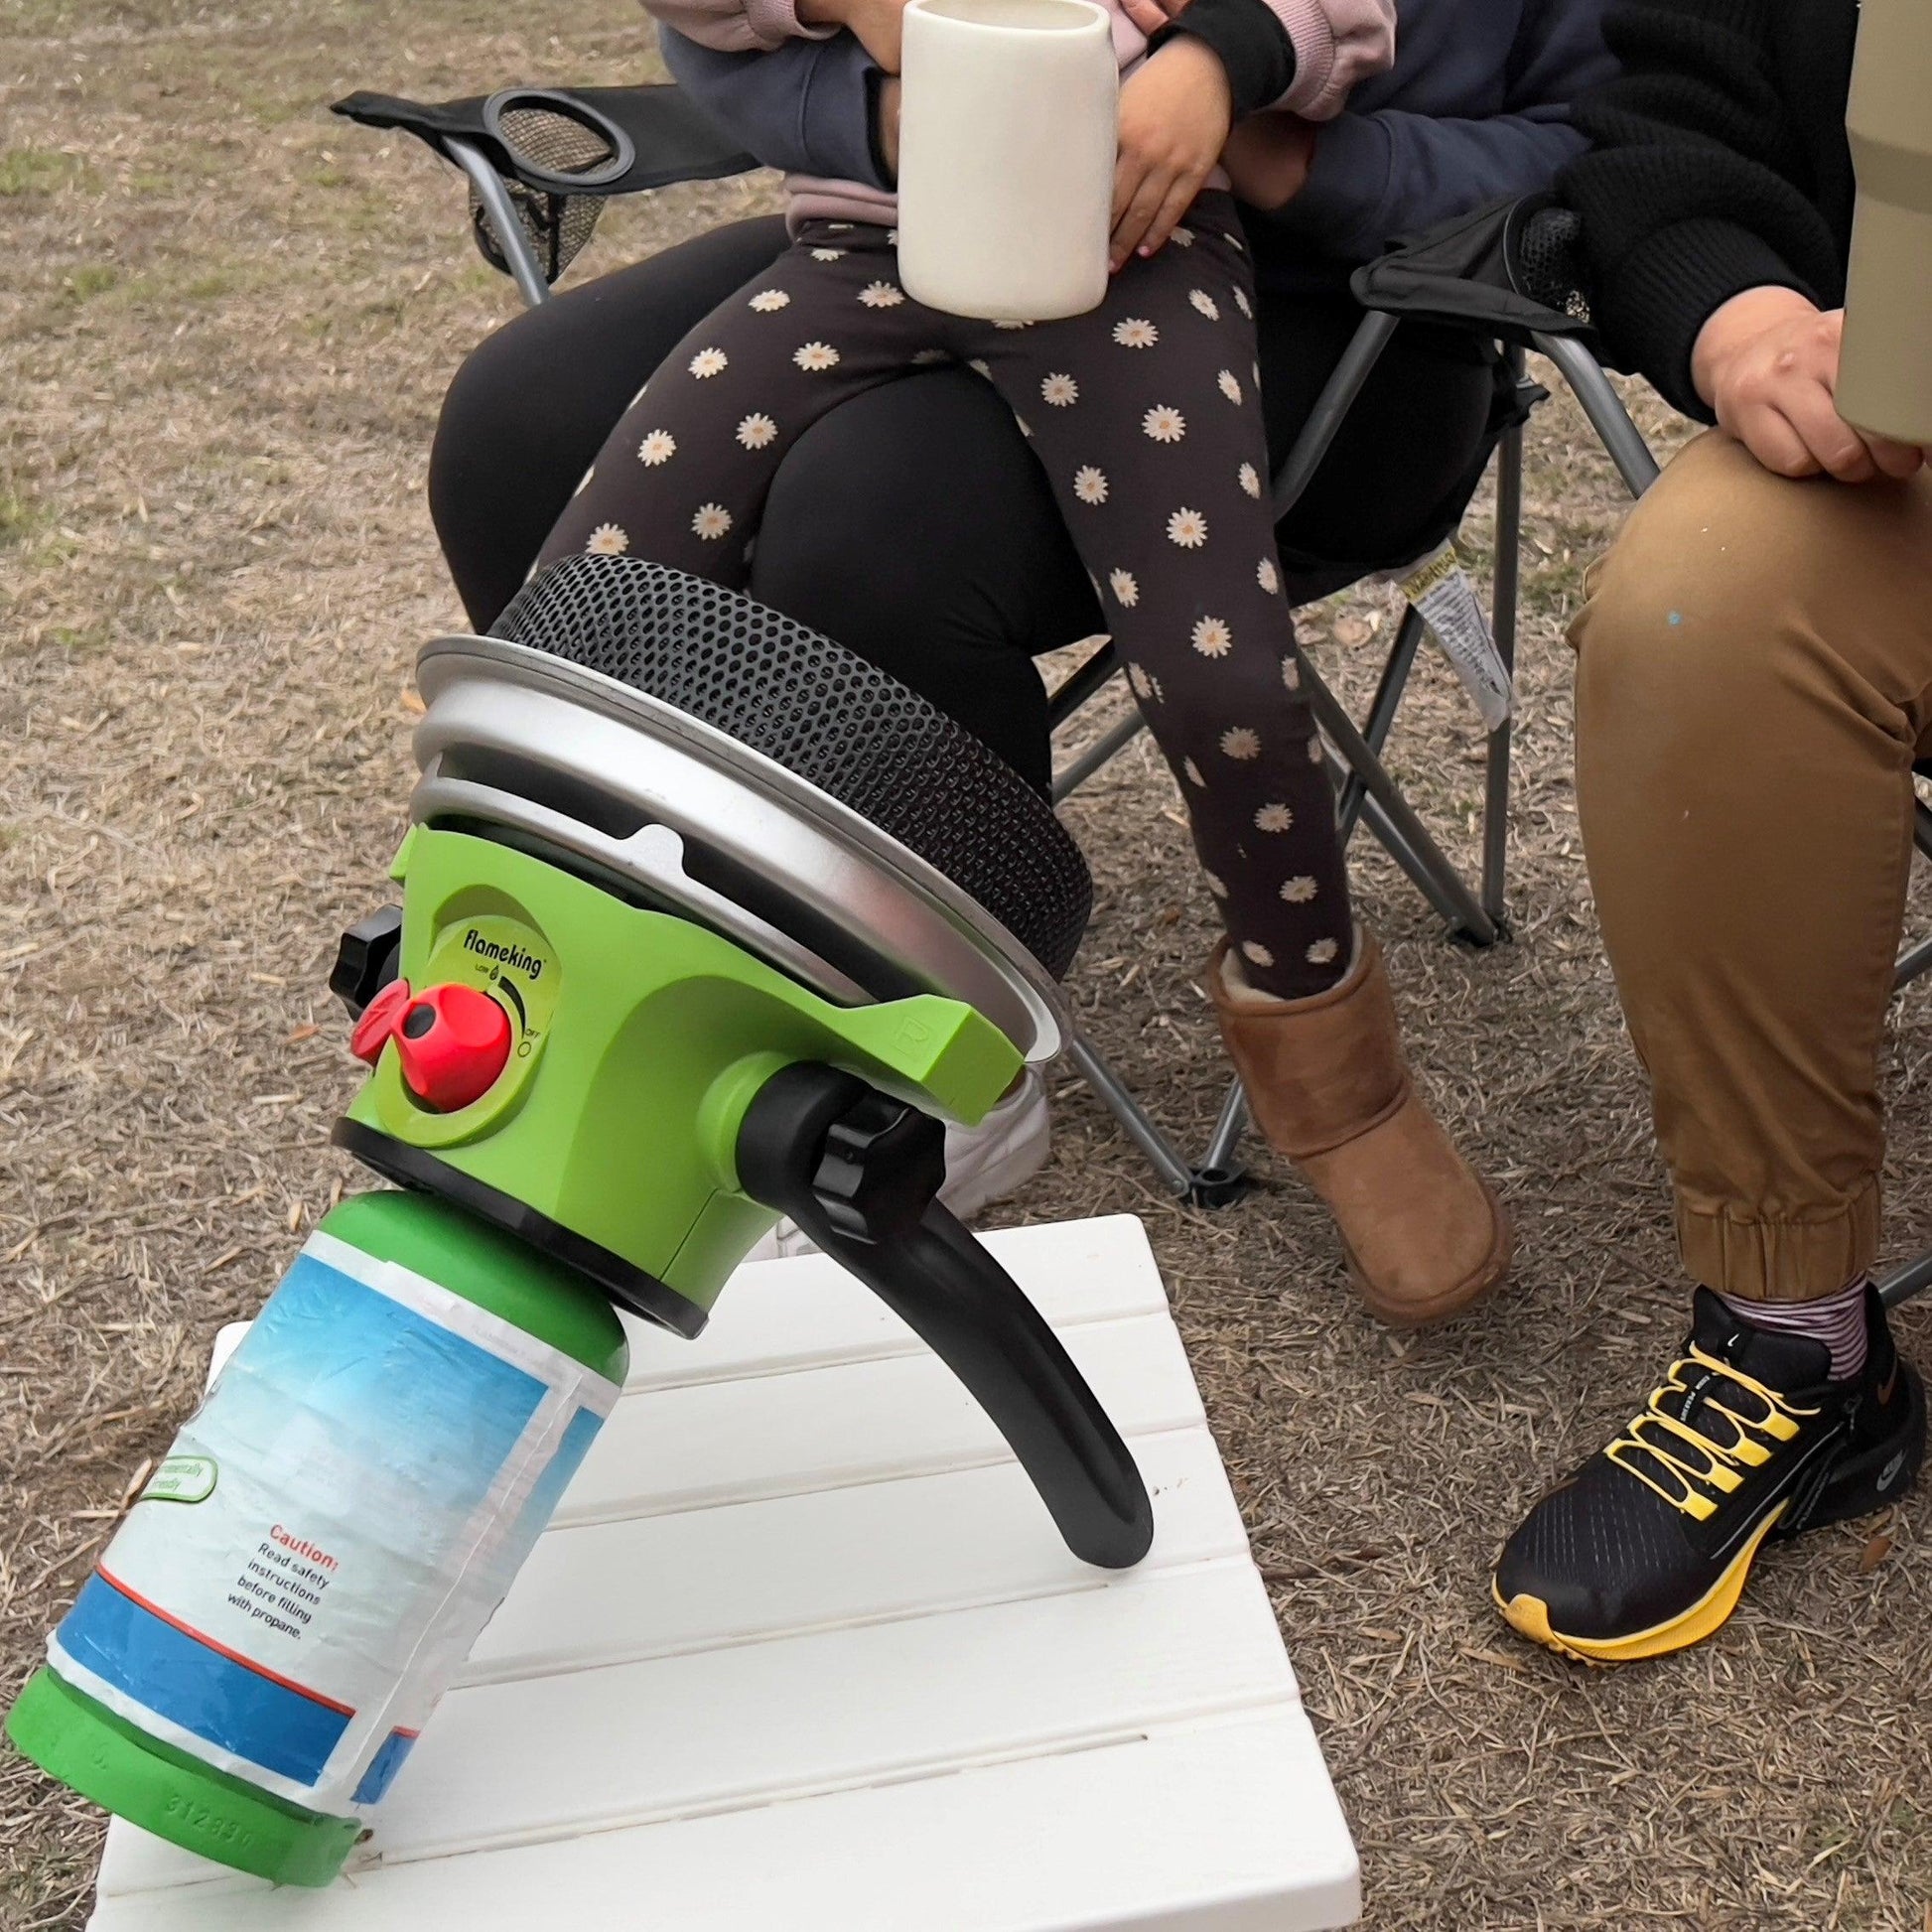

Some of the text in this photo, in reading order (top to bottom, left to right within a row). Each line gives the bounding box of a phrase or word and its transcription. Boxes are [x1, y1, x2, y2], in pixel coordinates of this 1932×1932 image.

[464, 929, 542, 980] flameking
[247, 1558, 321, 1605] instructions
[258, 1543, 330, 1589] Read safety
[227, 1593, 301, 1640] with propane.
[237, 1574, 312, 1624] before filling
